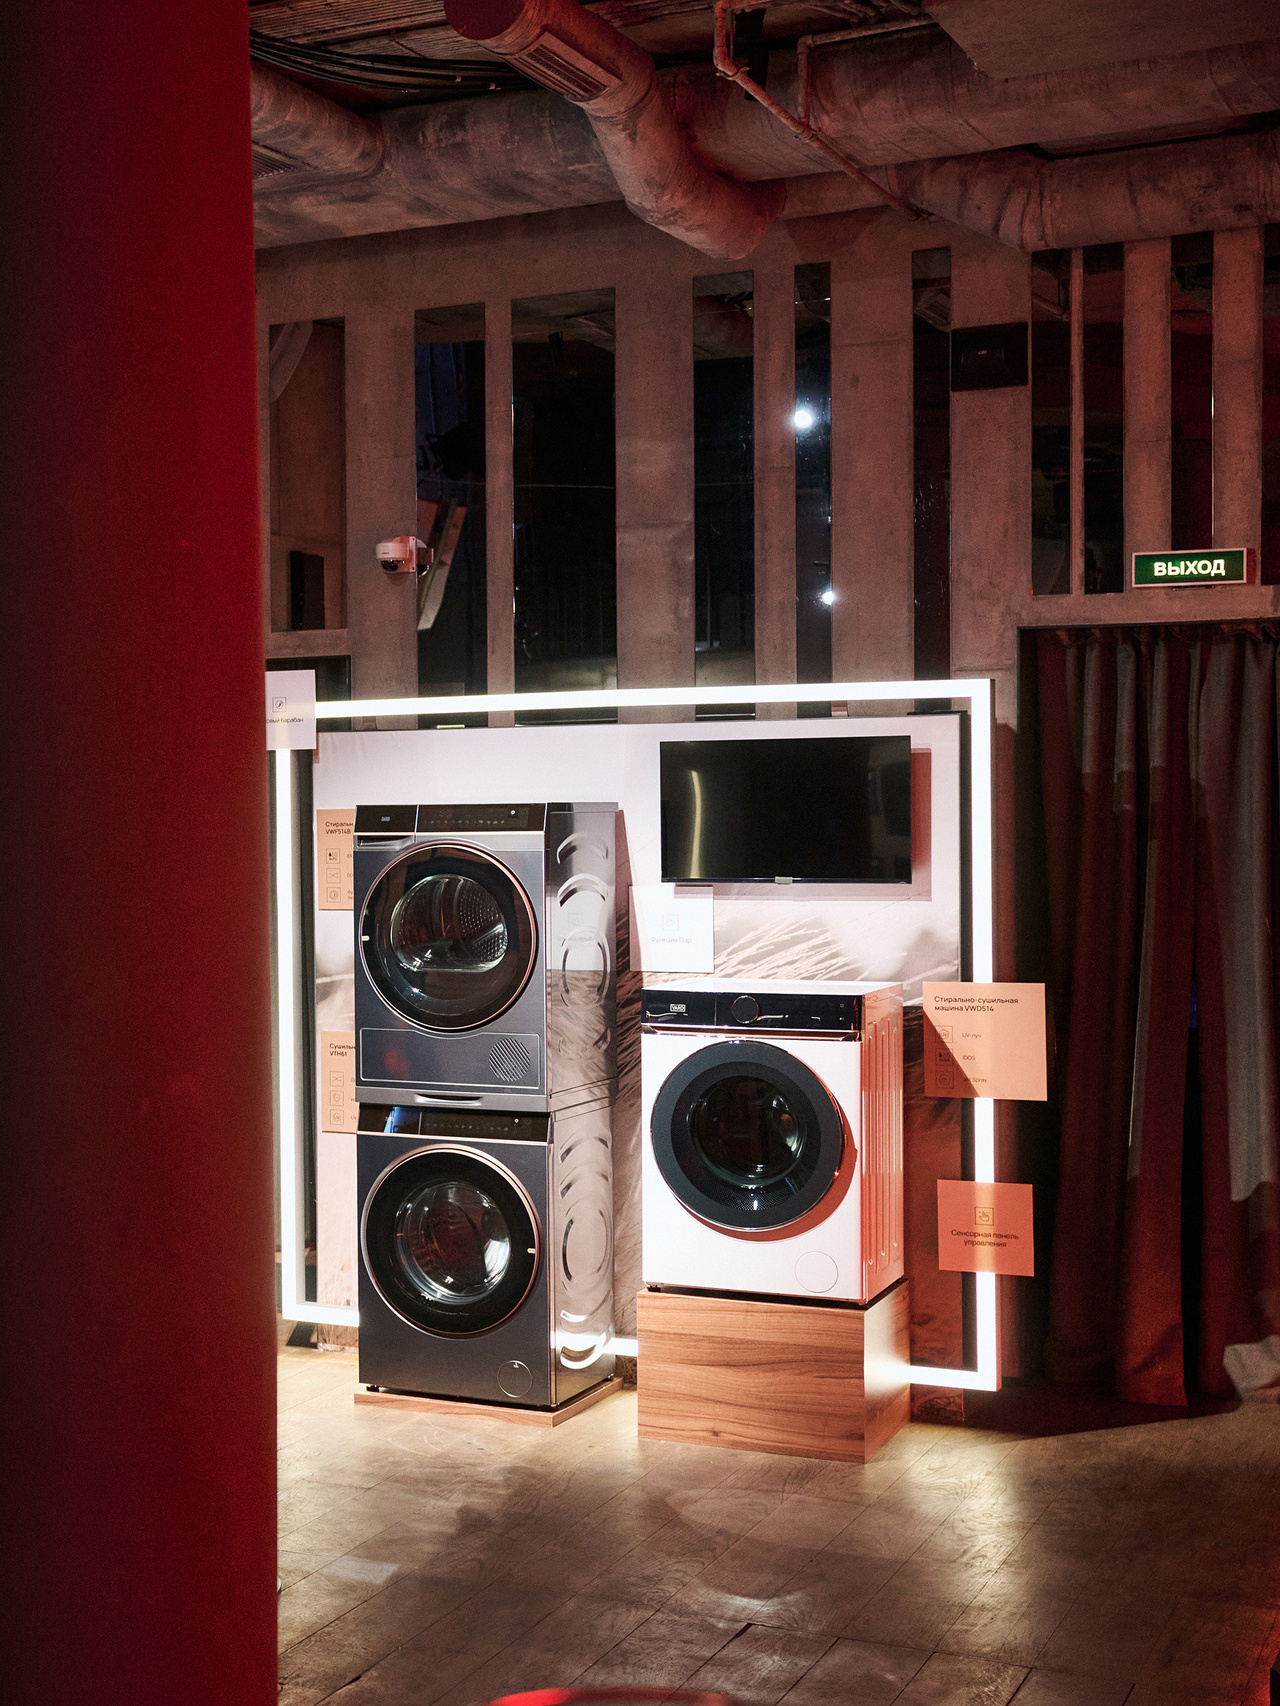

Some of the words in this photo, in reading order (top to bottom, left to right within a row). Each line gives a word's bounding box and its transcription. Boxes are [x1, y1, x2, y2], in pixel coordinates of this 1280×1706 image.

[1153, 559, 1225, 576] ВЫХОД
[934, 996, 1019, 1004] Стирально-сушильная
[951, 1229, 992, 1238] Сенсорная
